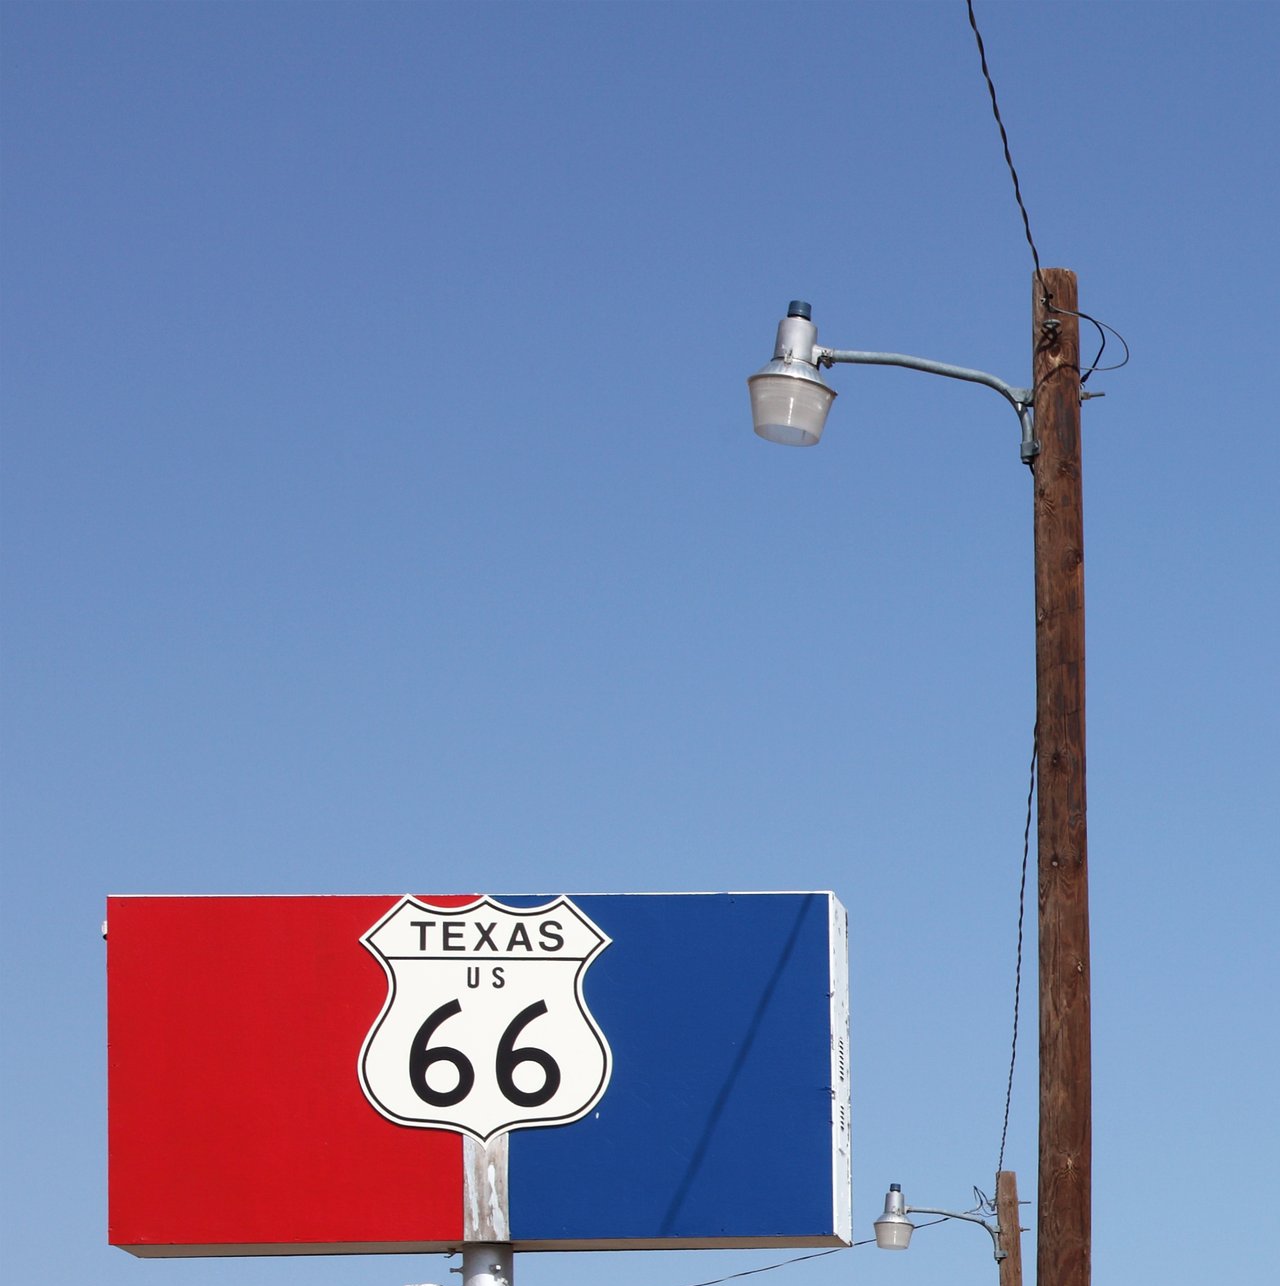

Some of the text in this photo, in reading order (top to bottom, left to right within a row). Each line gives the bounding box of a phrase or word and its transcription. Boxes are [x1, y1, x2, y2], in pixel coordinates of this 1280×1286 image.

[410, 920, 564, 952] TEXAS
[467, 966, 505, 989] US
[409, 998, 561, 1108] 66
